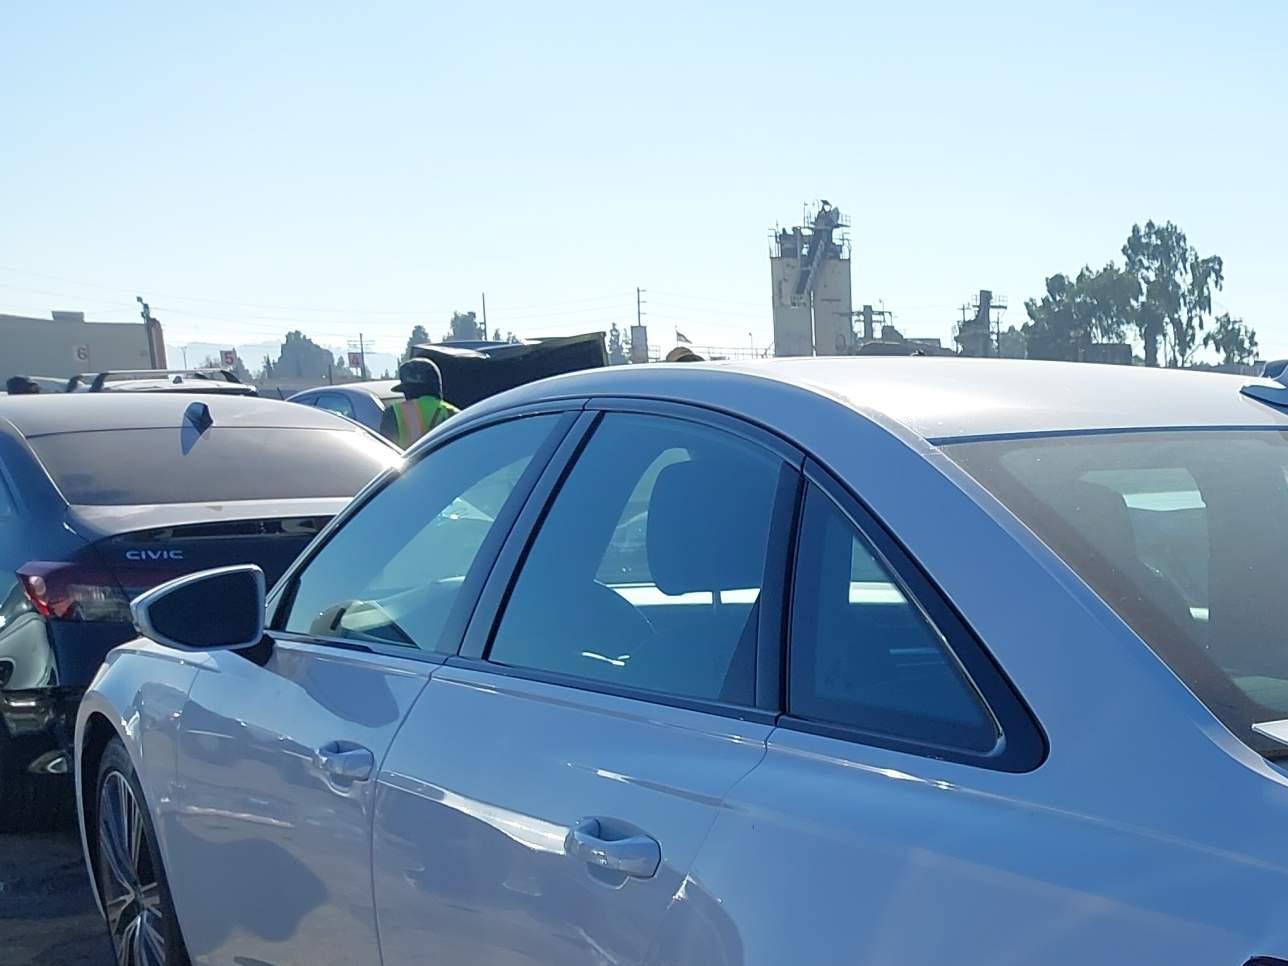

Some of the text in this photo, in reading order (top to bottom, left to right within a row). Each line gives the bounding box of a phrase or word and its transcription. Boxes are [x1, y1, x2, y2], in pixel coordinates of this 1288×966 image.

[77, 347, 87, 360] 6
[224, 352, 234, 366] 5
[126, 549, 184, 560] CIVIC
